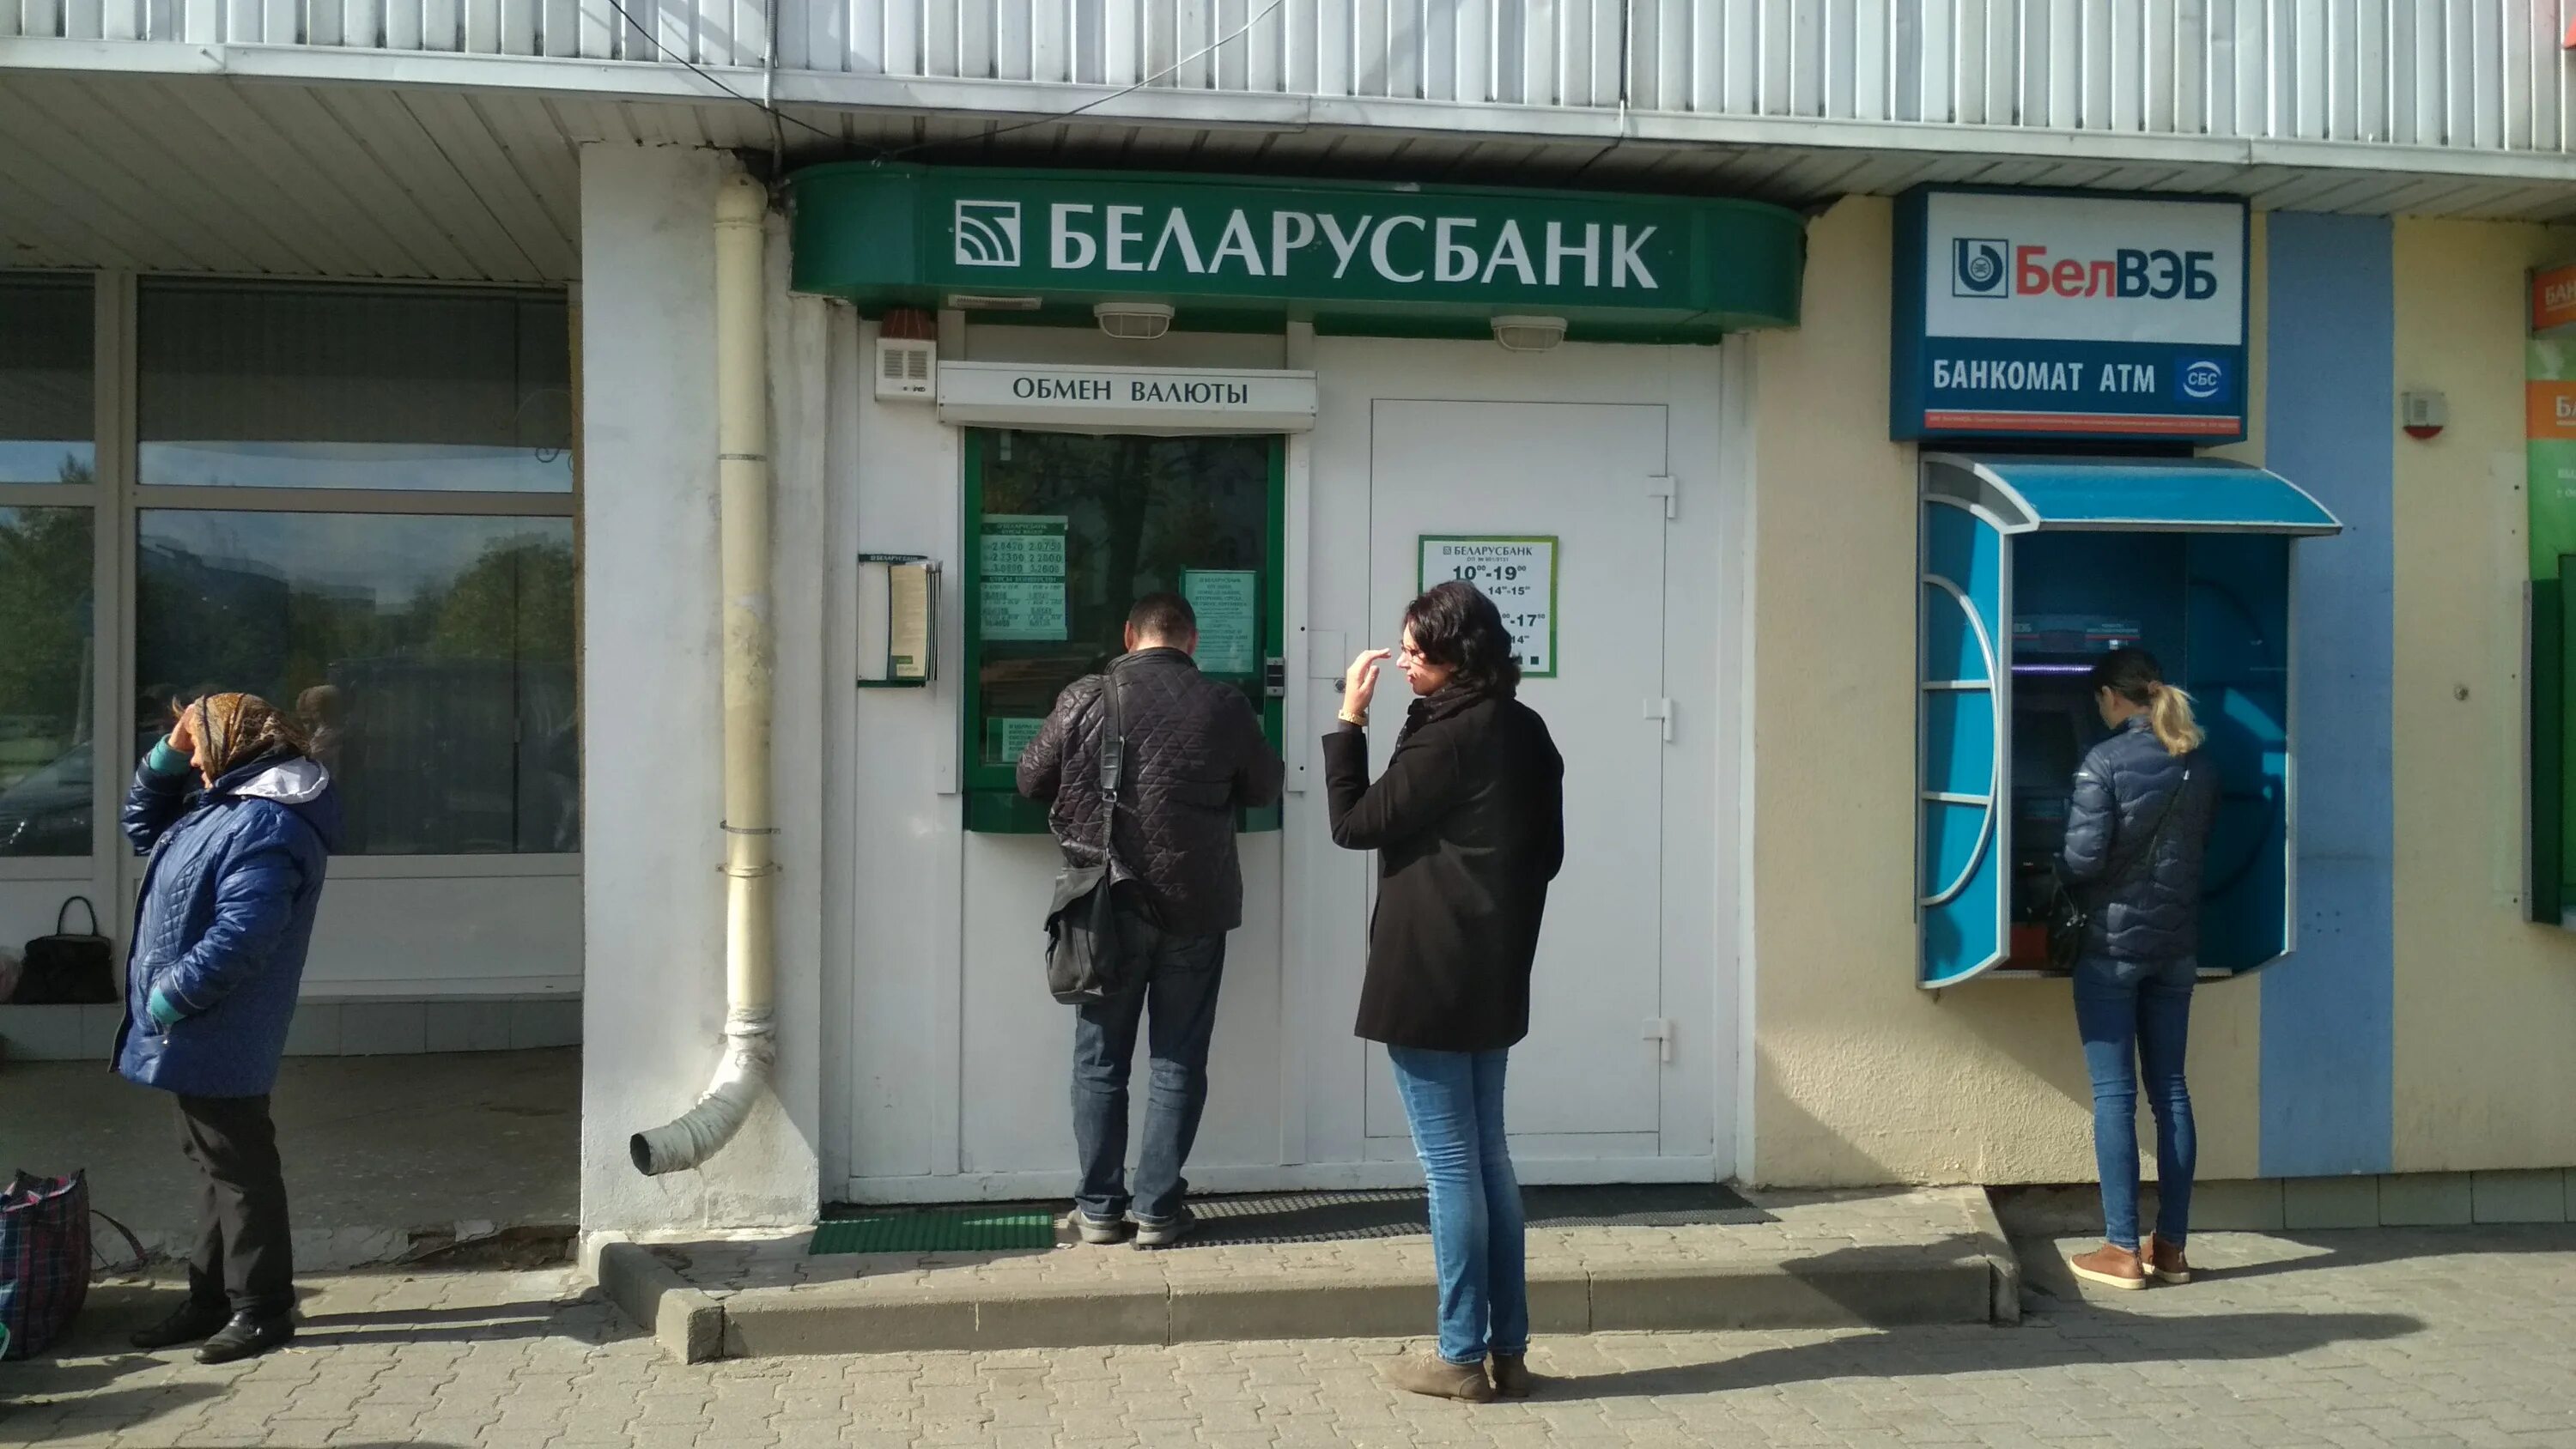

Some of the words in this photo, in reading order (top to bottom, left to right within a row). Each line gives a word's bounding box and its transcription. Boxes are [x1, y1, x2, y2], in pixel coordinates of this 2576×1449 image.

[1049, 202, 1659, 289] БЕЛАРУСБАНК
[2015, 245, 2217, 300] БелВЭБ
[1012, 377, 1112, 402] ОБМЕН
[1131, 381, 1249, 404] ВАЛЮТЫ
[1934, 359, 2083, 392] БАНКОМАТ
[2188, 371, 2218, 387] СБС
[1455, 546, 1533, 556] БЕЛАРУСБАНК
